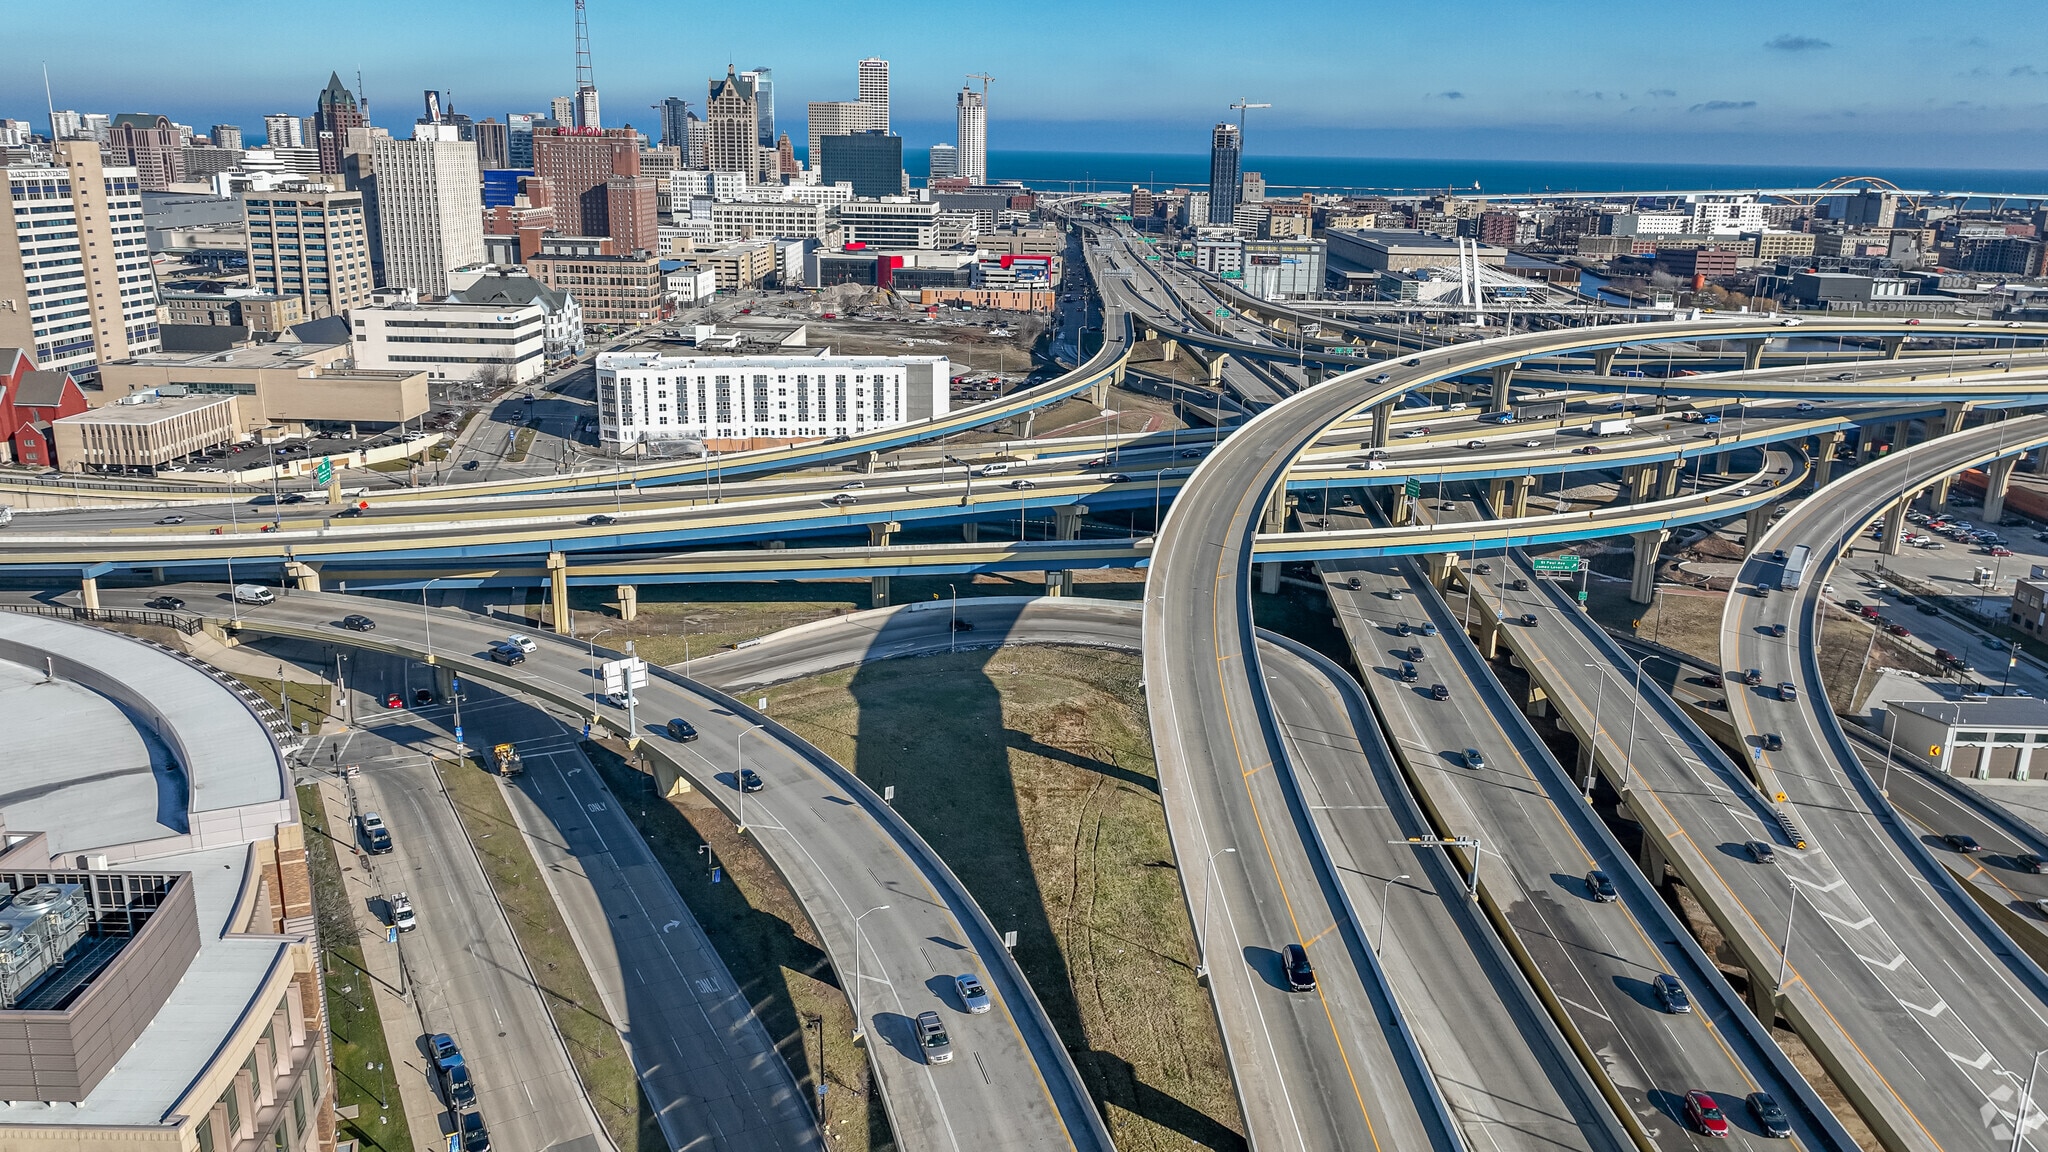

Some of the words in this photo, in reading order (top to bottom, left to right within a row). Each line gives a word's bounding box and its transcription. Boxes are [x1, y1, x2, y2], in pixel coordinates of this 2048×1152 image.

[557, 126, 602, 136] HILTON
[1938, 277, 1970, 288] 1903
[1831, 302, 1957, 313] HARLEY-DAVIDSON
[587, 801, 608, 813] ONLY
[695, 976, 722, 993] ONLY
